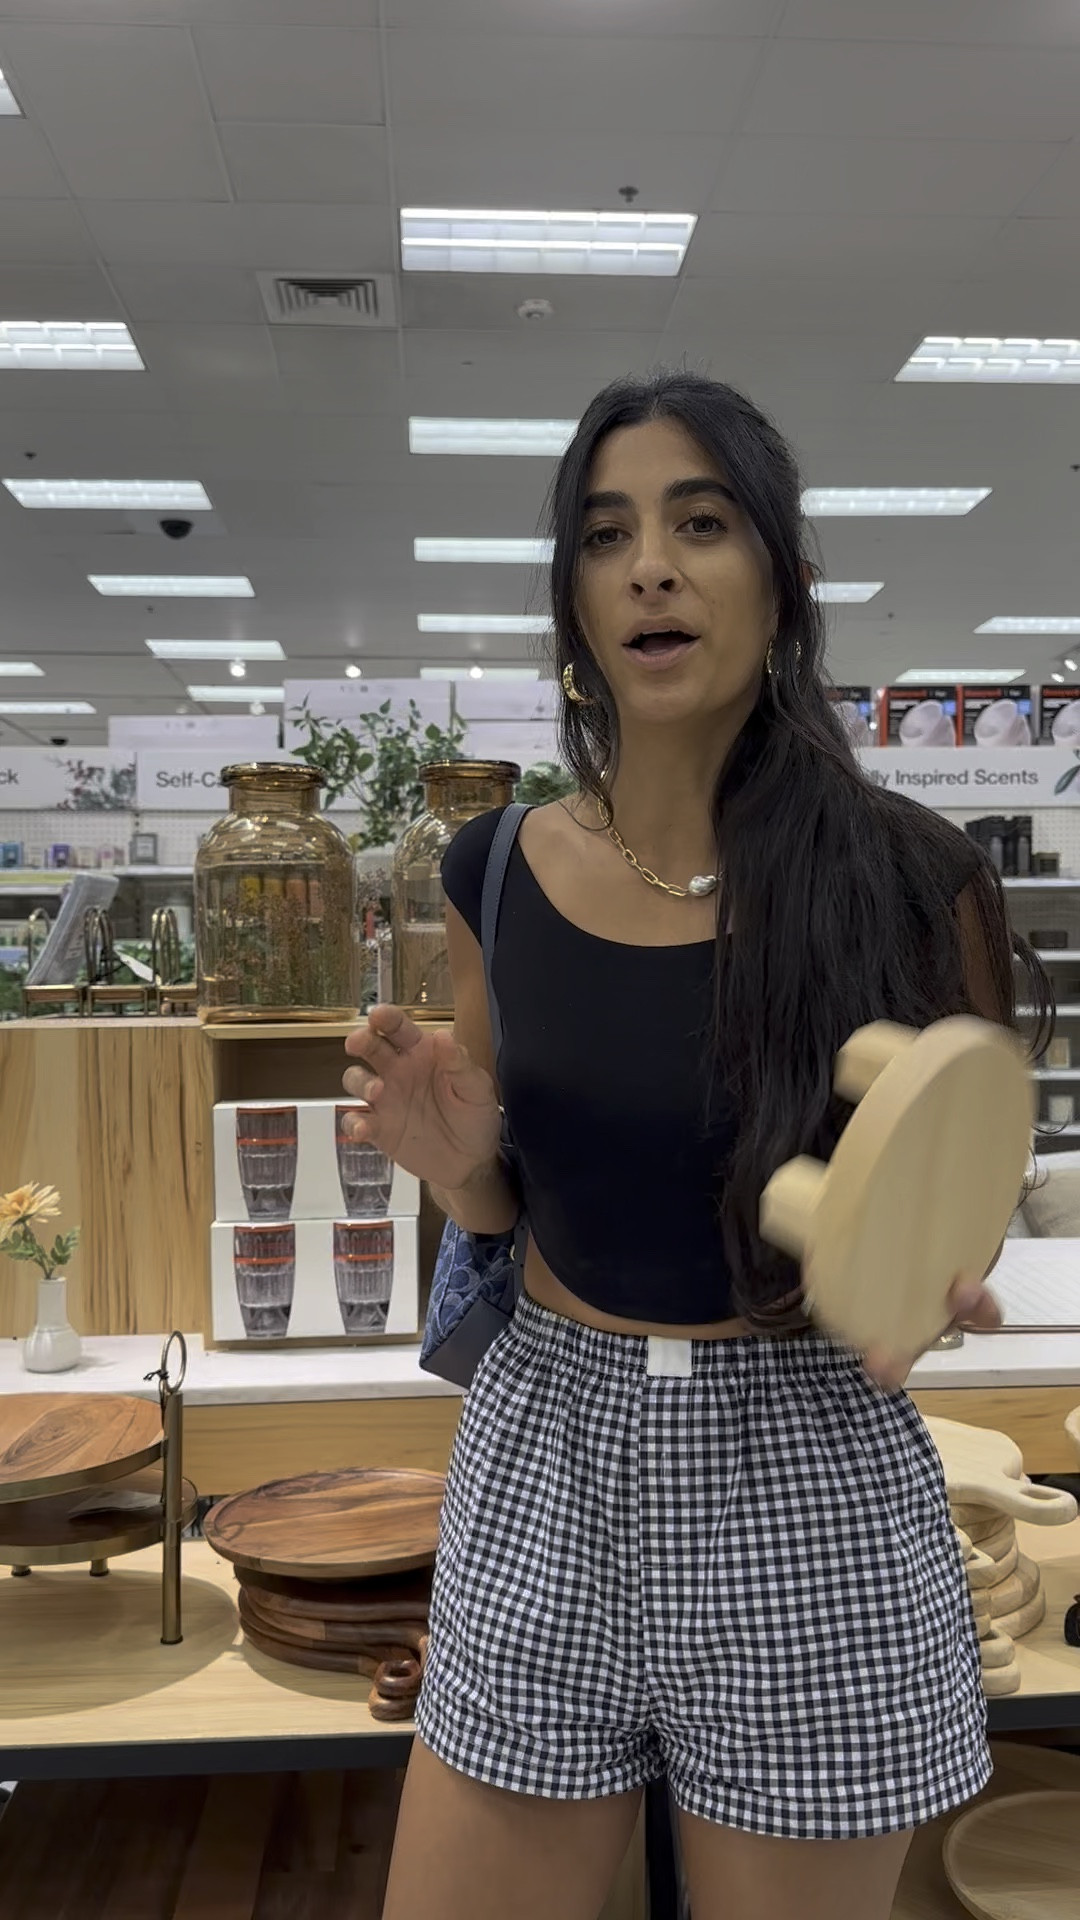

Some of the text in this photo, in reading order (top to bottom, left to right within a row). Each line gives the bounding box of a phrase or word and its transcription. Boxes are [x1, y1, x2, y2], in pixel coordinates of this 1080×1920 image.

[156, 769, 221, 788] Self-C
[895, 769, 969, 788] Inspired
[974, 768, 1039, 786] Scents
